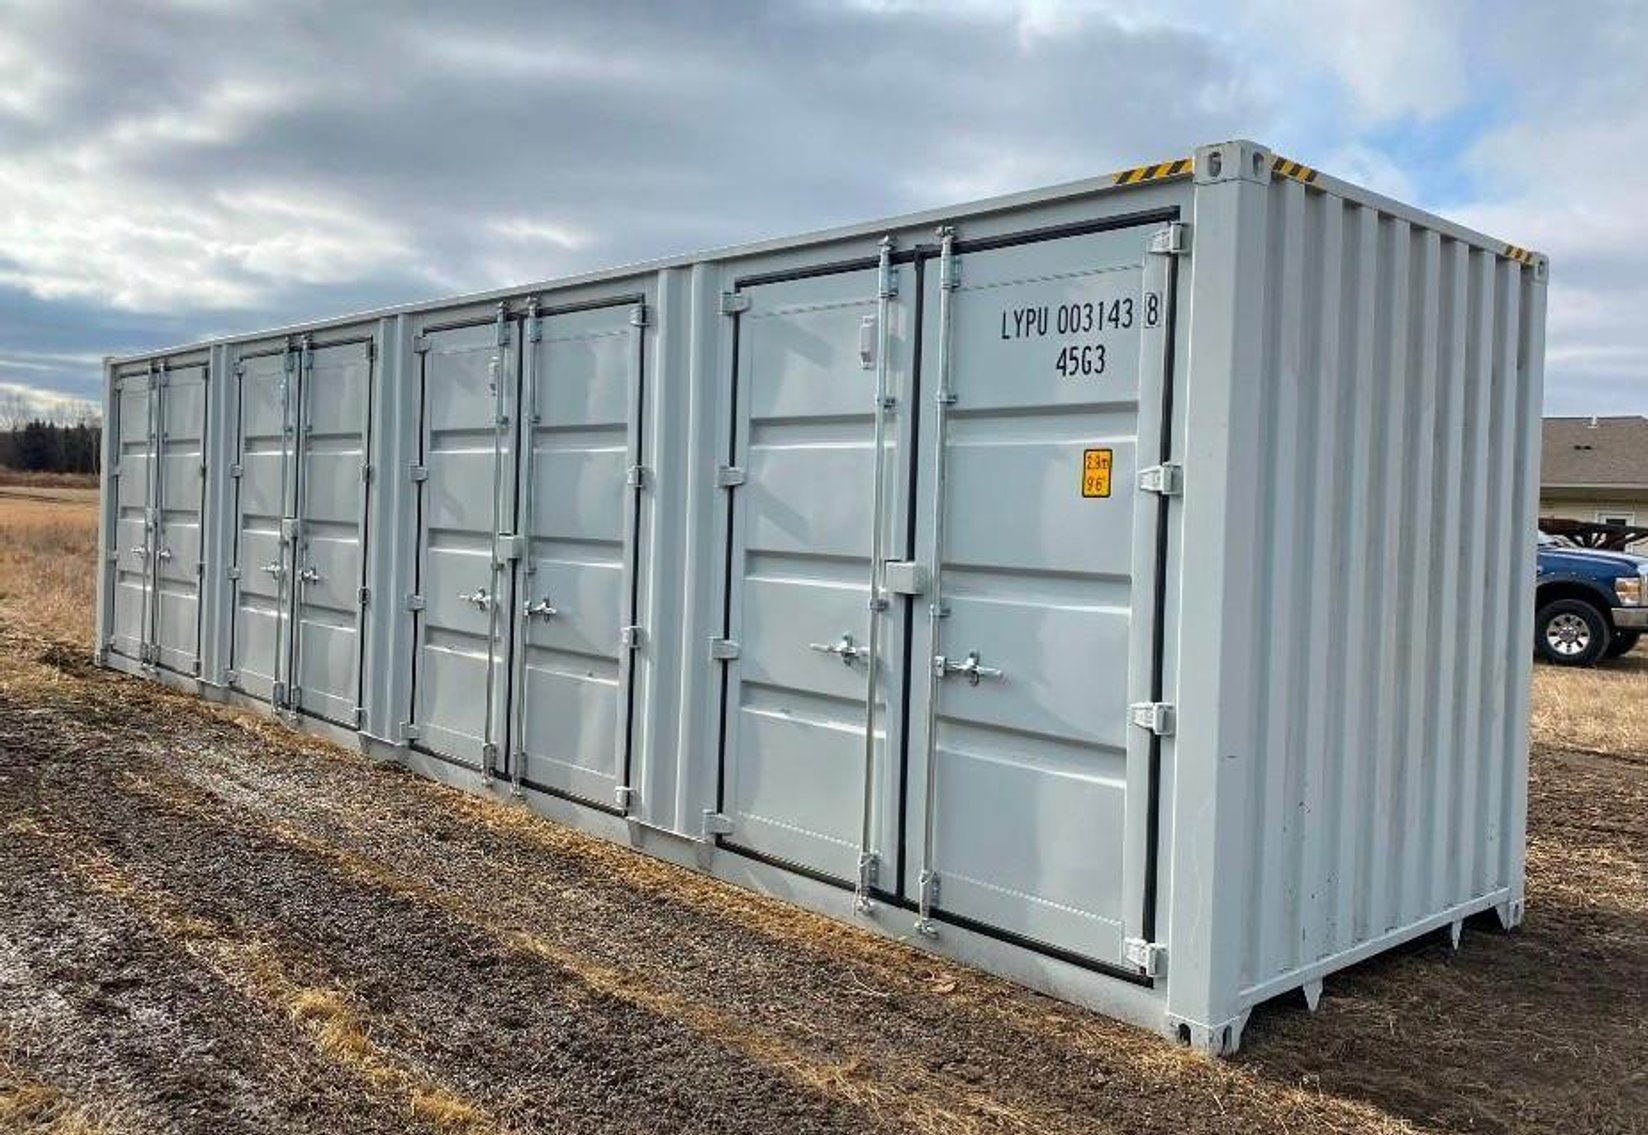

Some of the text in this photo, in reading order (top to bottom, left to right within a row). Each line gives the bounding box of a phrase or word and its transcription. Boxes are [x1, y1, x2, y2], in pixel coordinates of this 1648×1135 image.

[1001, 293, 1158, 339] LYPU 003143 8
[1056, 344, 1106, 376] 45G3
